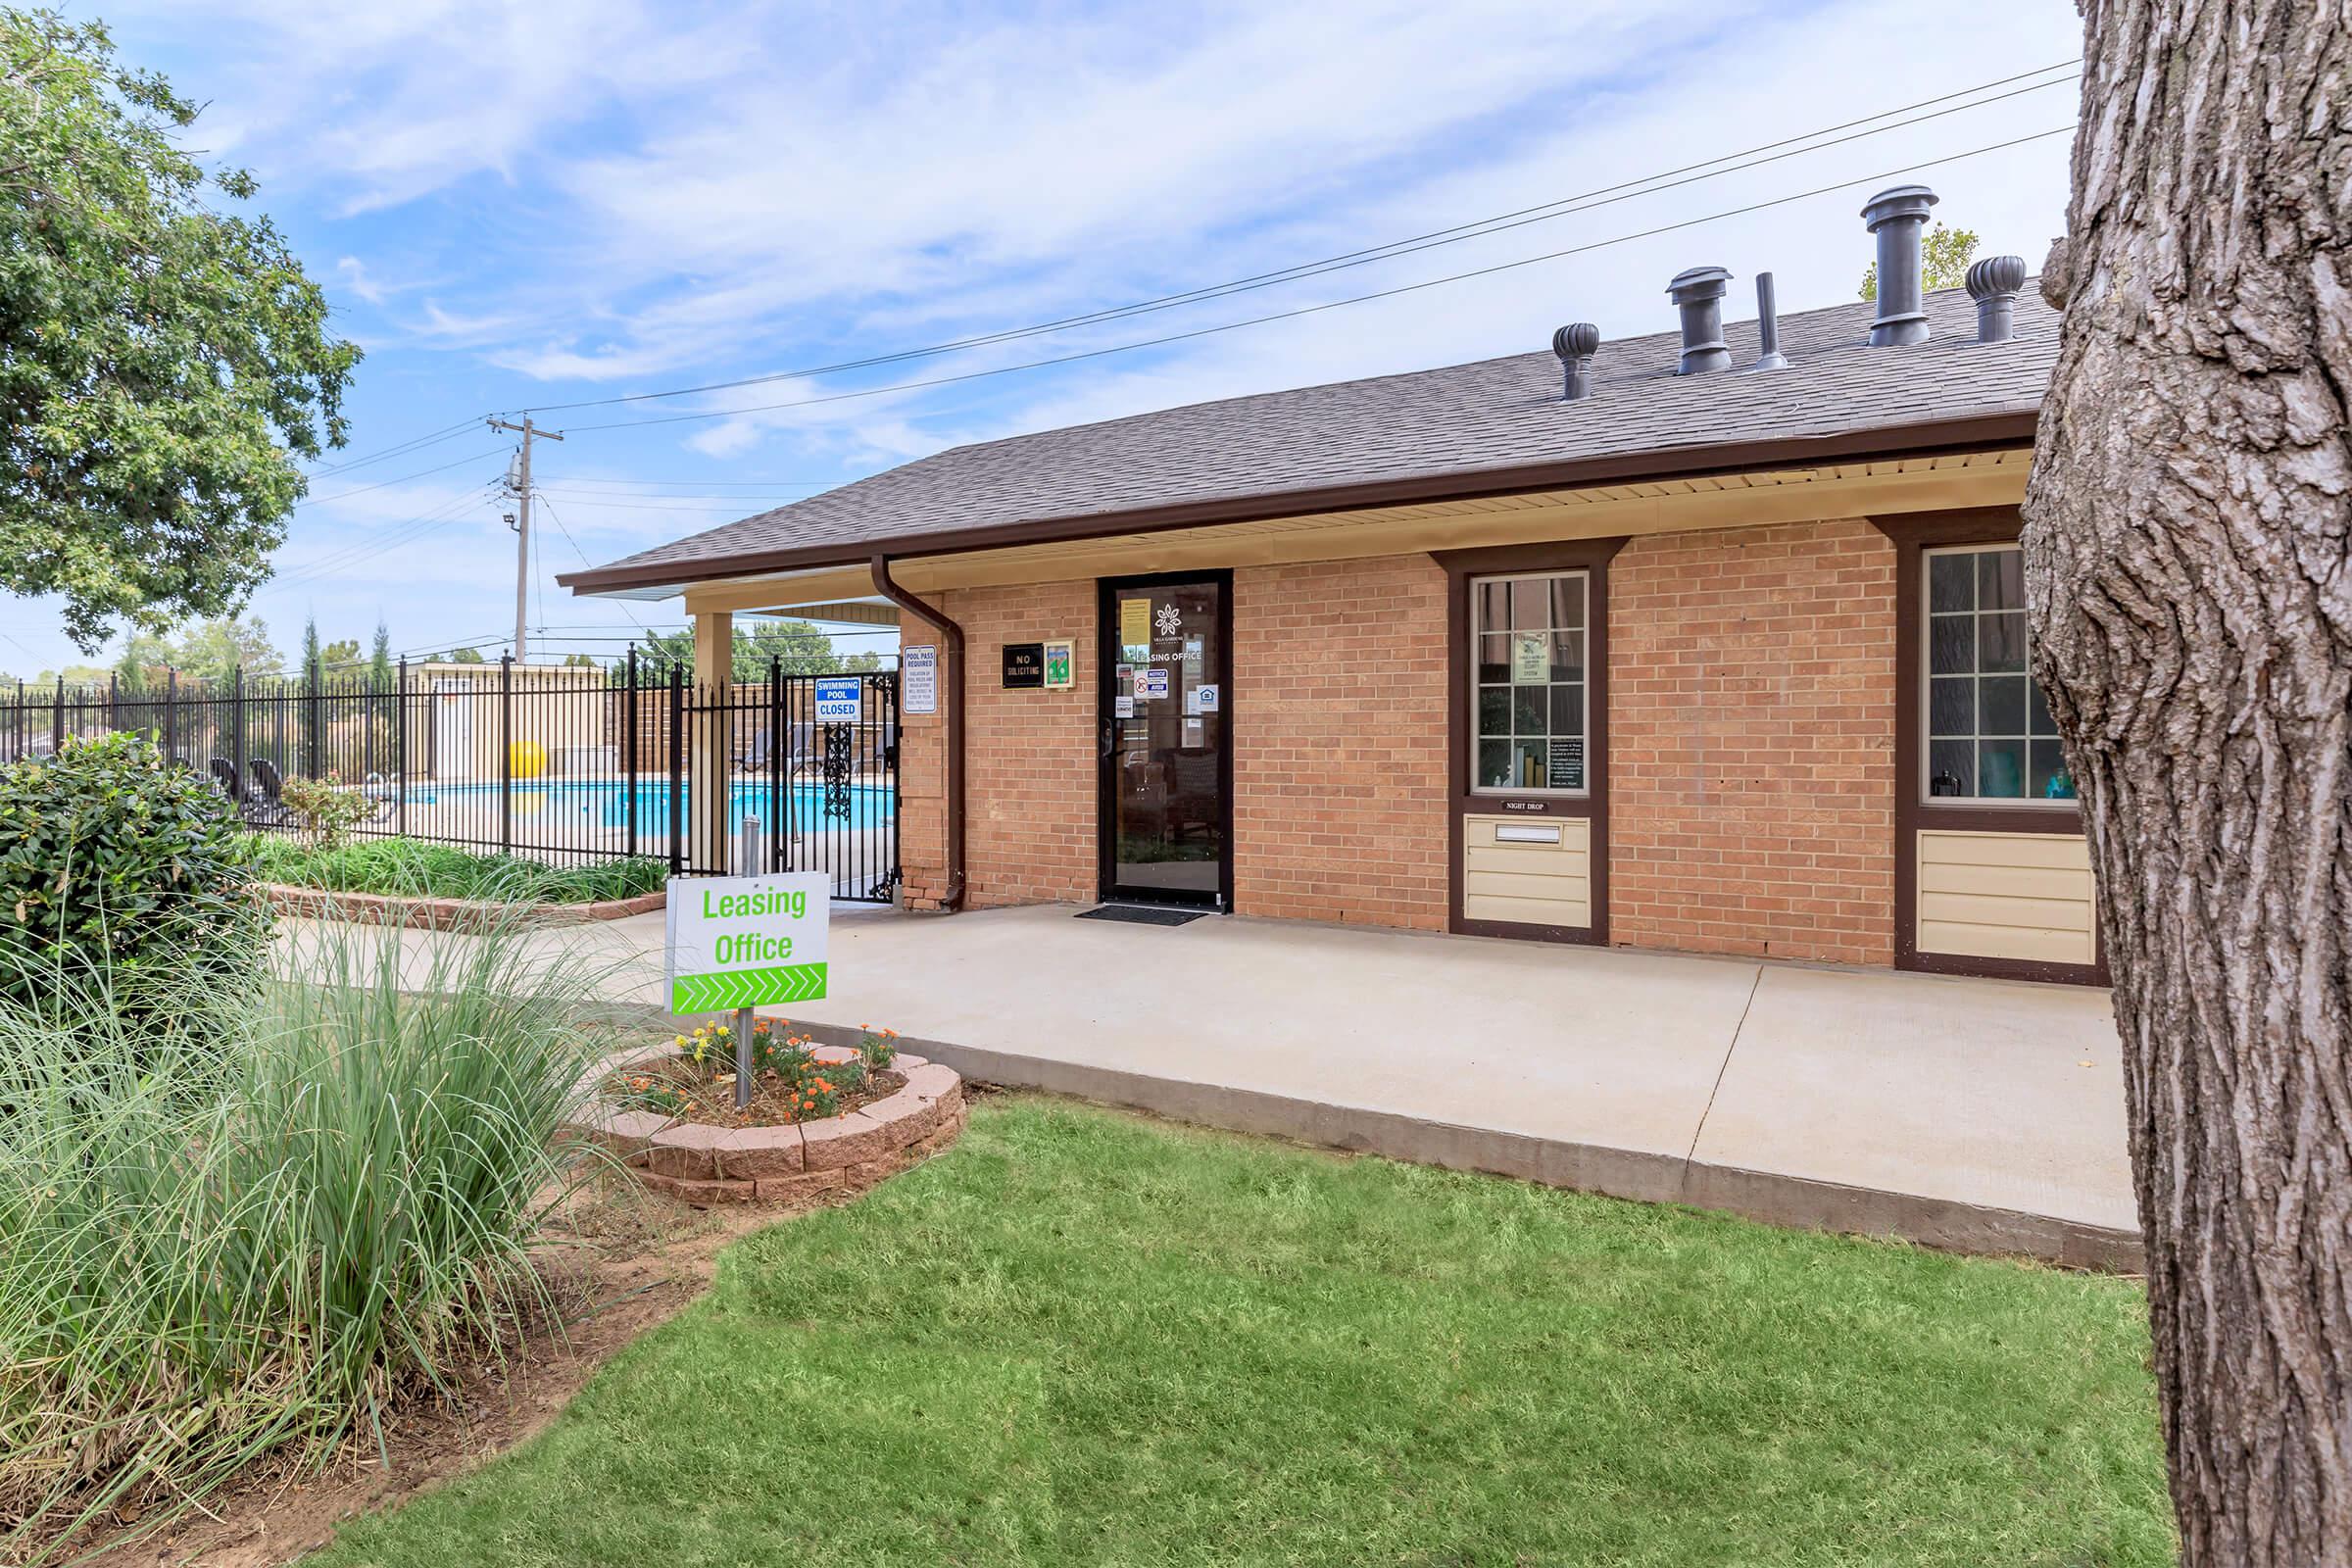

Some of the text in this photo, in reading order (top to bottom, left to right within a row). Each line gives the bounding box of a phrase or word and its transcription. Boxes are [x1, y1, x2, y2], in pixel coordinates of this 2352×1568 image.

[906, 652, 920, 661] POOL
[1016, 655, 1031, 664] NO
[1171, 652, 1201, 662] OFFICE
[1007, 666, 1040, 676] SOLICITING
[817, 681, 858, 691] SWIMMING
[827, 690, 848, 700] POOL
[820, 704, 856, 715] CLOSED
[1505, 802, 1544, 811] NIGHT DROP
[703, 886, 807, 919] Leasing
[714, 932, 793, 965] Office
